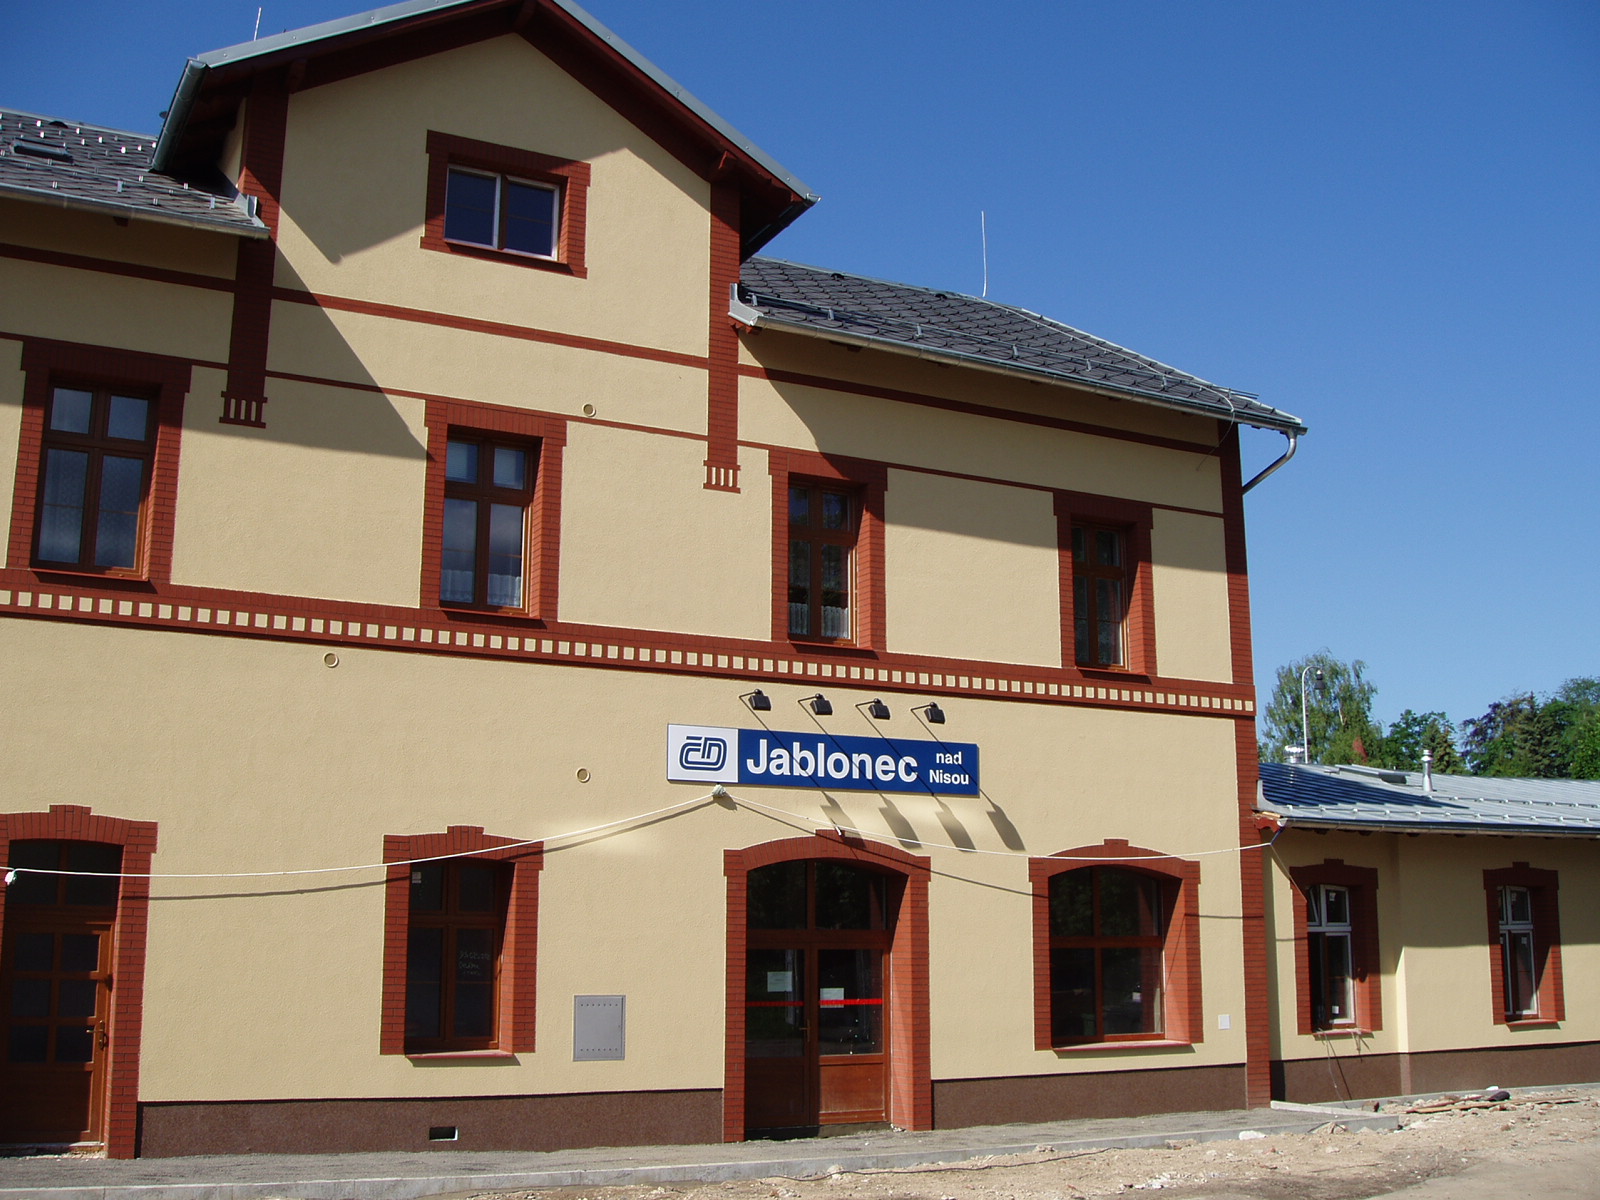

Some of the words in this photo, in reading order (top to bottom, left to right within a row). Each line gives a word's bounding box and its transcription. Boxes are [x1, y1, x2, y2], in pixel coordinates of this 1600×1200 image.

[746, 738, 918, 783] Jablonec
[936, 750, 962, 765] nad
[929, 769, 970, 785] Nisou
